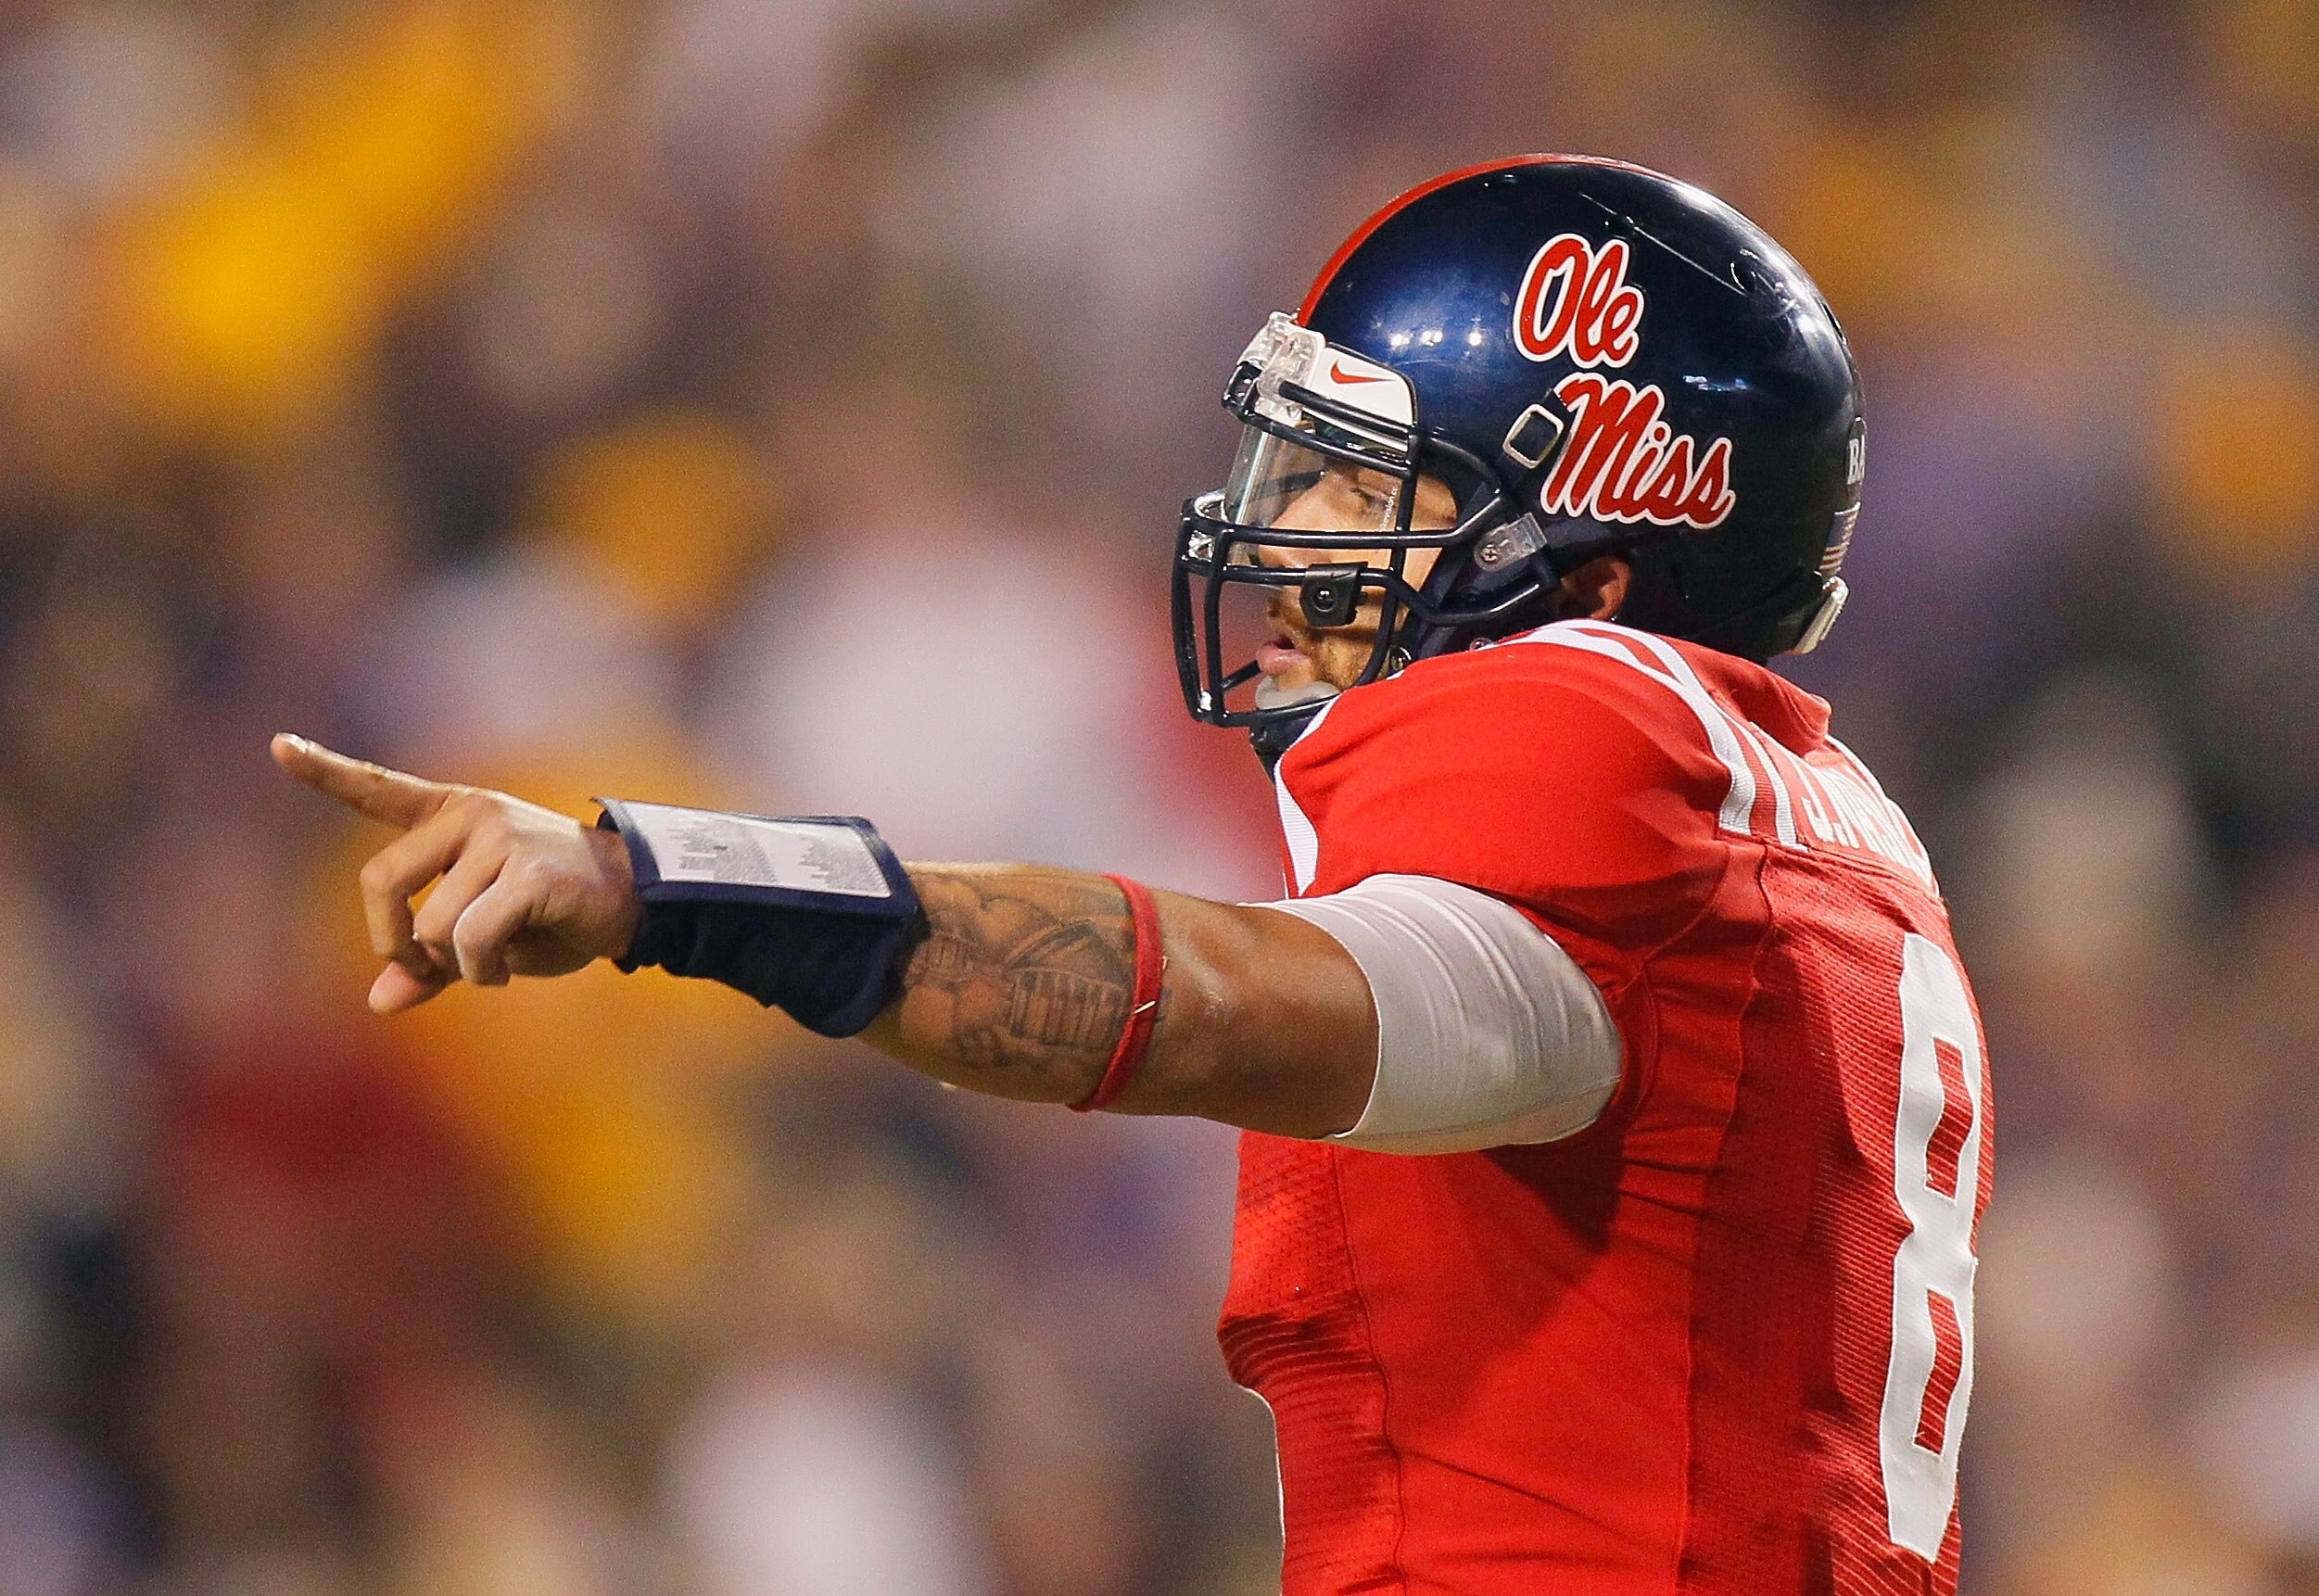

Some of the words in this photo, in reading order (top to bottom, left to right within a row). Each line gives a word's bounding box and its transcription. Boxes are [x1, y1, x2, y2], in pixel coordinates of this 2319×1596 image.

[1514, 234, 1644, 368] Ole
[1540, 373, 1736, 529] Miss
[1880, 932, 1981, 1564] 8
